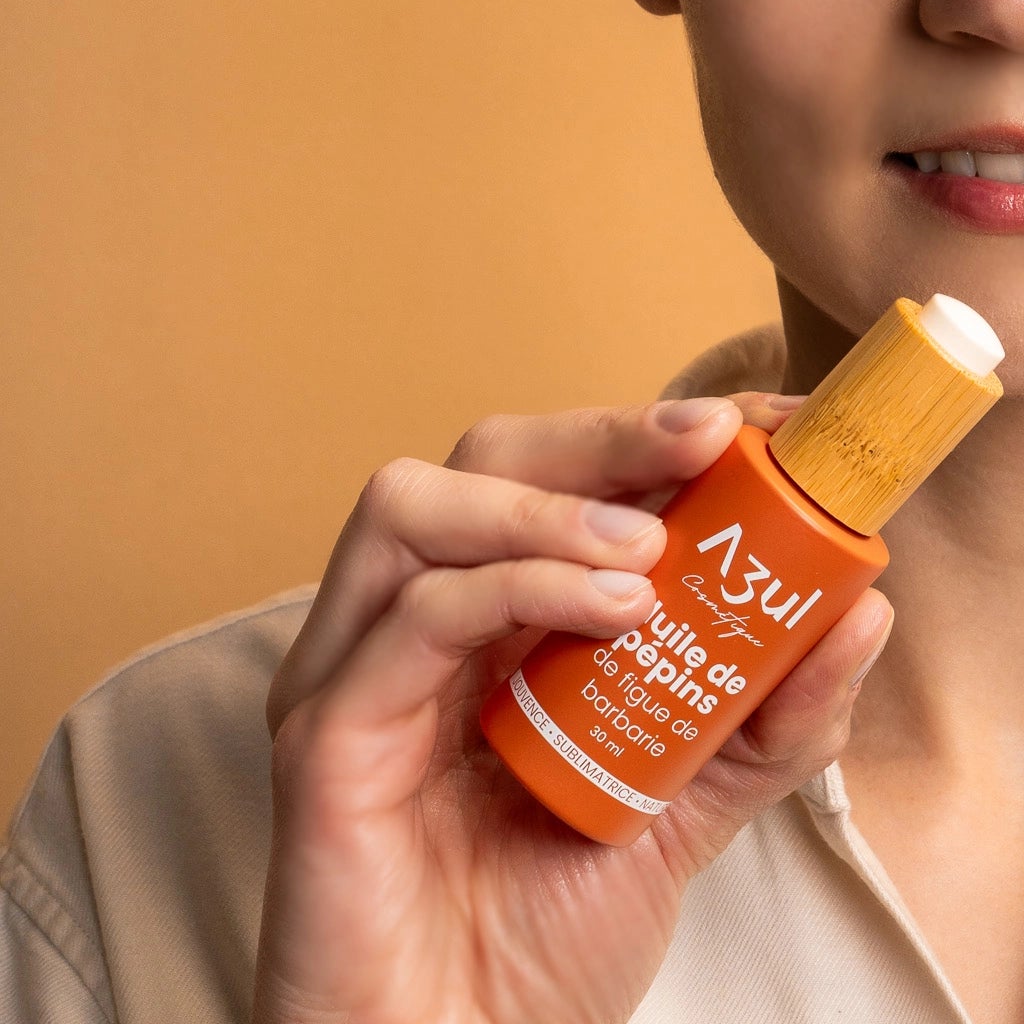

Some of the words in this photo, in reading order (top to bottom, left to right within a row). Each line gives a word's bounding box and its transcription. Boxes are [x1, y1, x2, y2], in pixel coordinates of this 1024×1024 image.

[593, 647, 619, 677] de
[617, 672, 670, 723] figue
[671, 720, 699, 741] de
[611, 629, 719, 714] pépins
[707, 659, 747, 695] de
[511, 676, 550, 731] JOUVENCE
[553, 734, 638, 804] SUBLIMATRICE
[581, 678, 666, 757] barbarie
[589, 726, 607, 743] 30
[604, 738, 625, 757] ml
